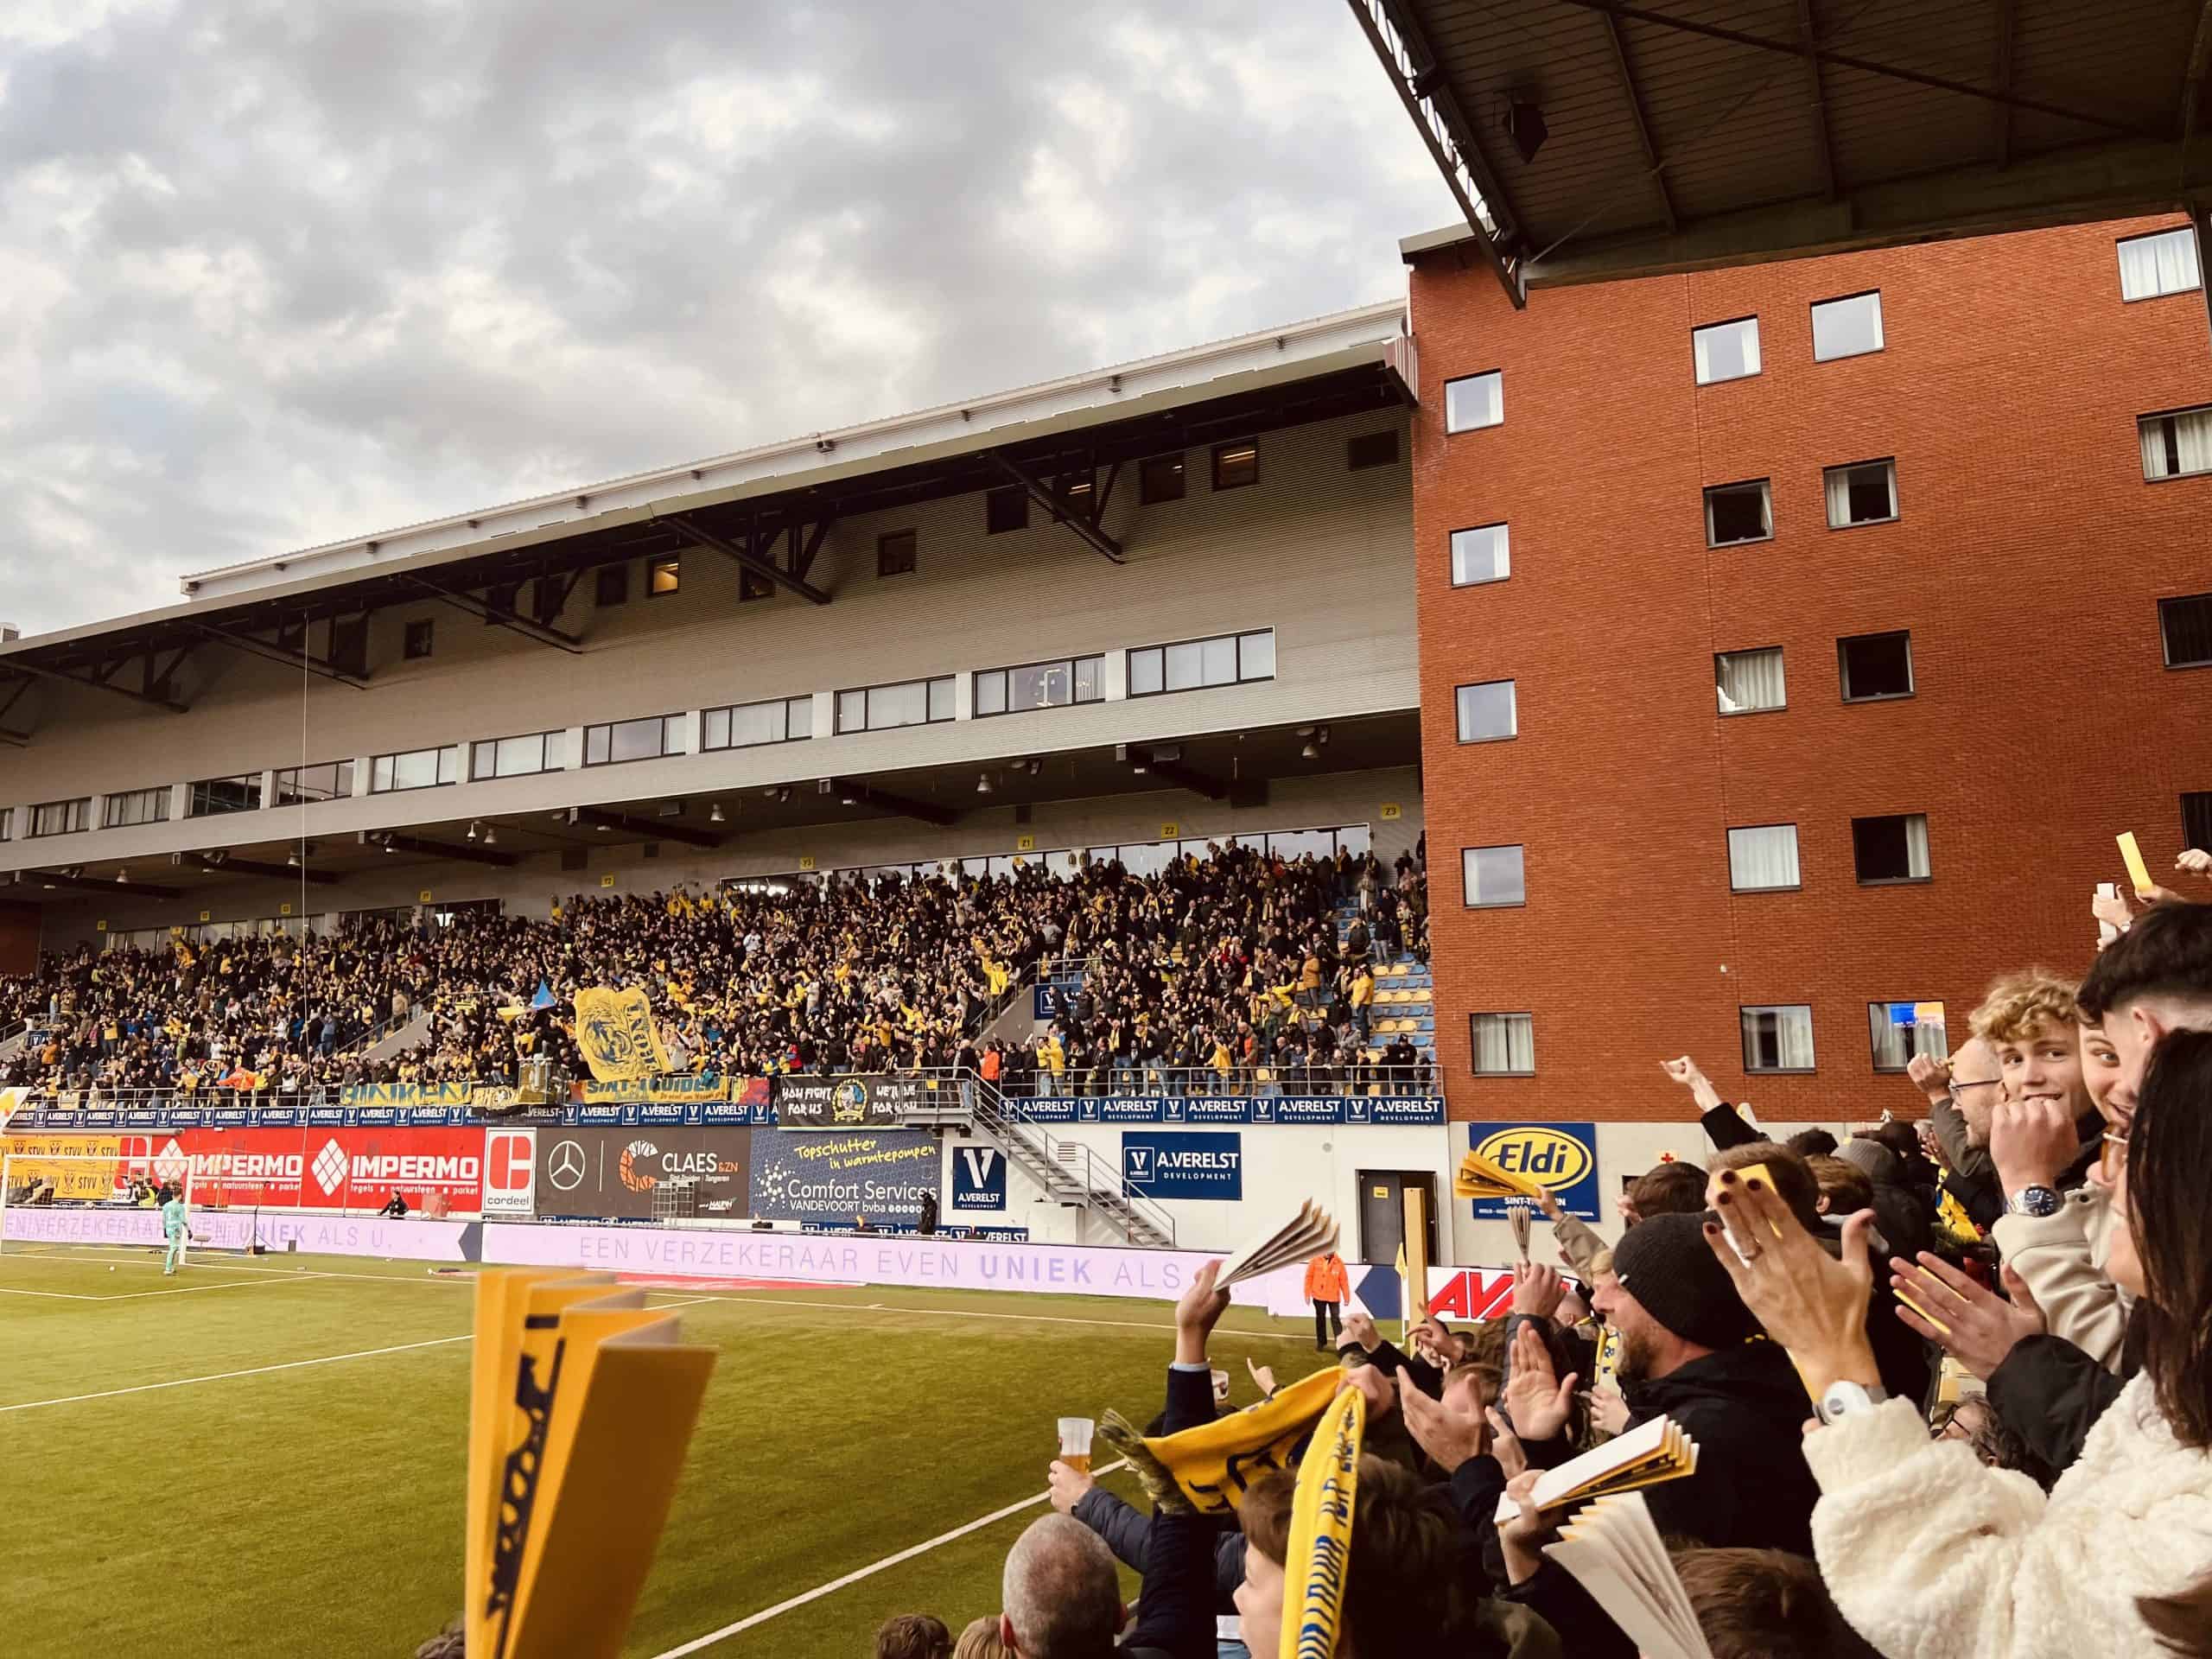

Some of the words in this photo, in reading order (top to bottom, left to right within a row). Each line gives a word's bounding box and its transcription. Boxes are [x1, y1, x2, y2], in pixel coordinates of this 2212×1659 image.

[1022, 1101, 1075, 1112] A.VERELST
[1103, 1100, 1158, 1112] A.VERELST
[1189, 1100, 1247, 1112] A.VERELST
[1279, 1100, 1341, 1112] A.VERELST
[1375, 1100, 1440, 1113] A.VERELST
[794, 1138, 877, 1160] Topschutter
[829, 1158, 841, 1170] in
[843, 1145, 937, 1168] warmtepompen
[1498, 1140, 1568, 1174] Eldi
[191, 1154, 303, 1176] IMPERMO
[351, 1155, 480, 1179] IMPERMO
[662, 1153, 718, 1173] CLAES
[1157, 1152, 1239, 1169] A.VERELST
[787, 1178, 860, 1199] Comfort
[865, 1180, 938, 1201] Services
[957, 1192, 1001, 1203] A.VERELST
[487, 1195, 530, 1205] cordeel
[789, 1199, 861, 1211] VANDEVOORT
[862, 1201, 887, 1213] bvba
[317, 1225, 359, 1247] ALS
[580, 1236, 629, 1259] EEN
[645, 1239, 858, 1273] VERZEKERAAR
[878, 1249, 958, 1277] EVEN
[981, 1255, 1092, 1284] UNIEK
[1114, 1261, 1180, 1289] ALS
